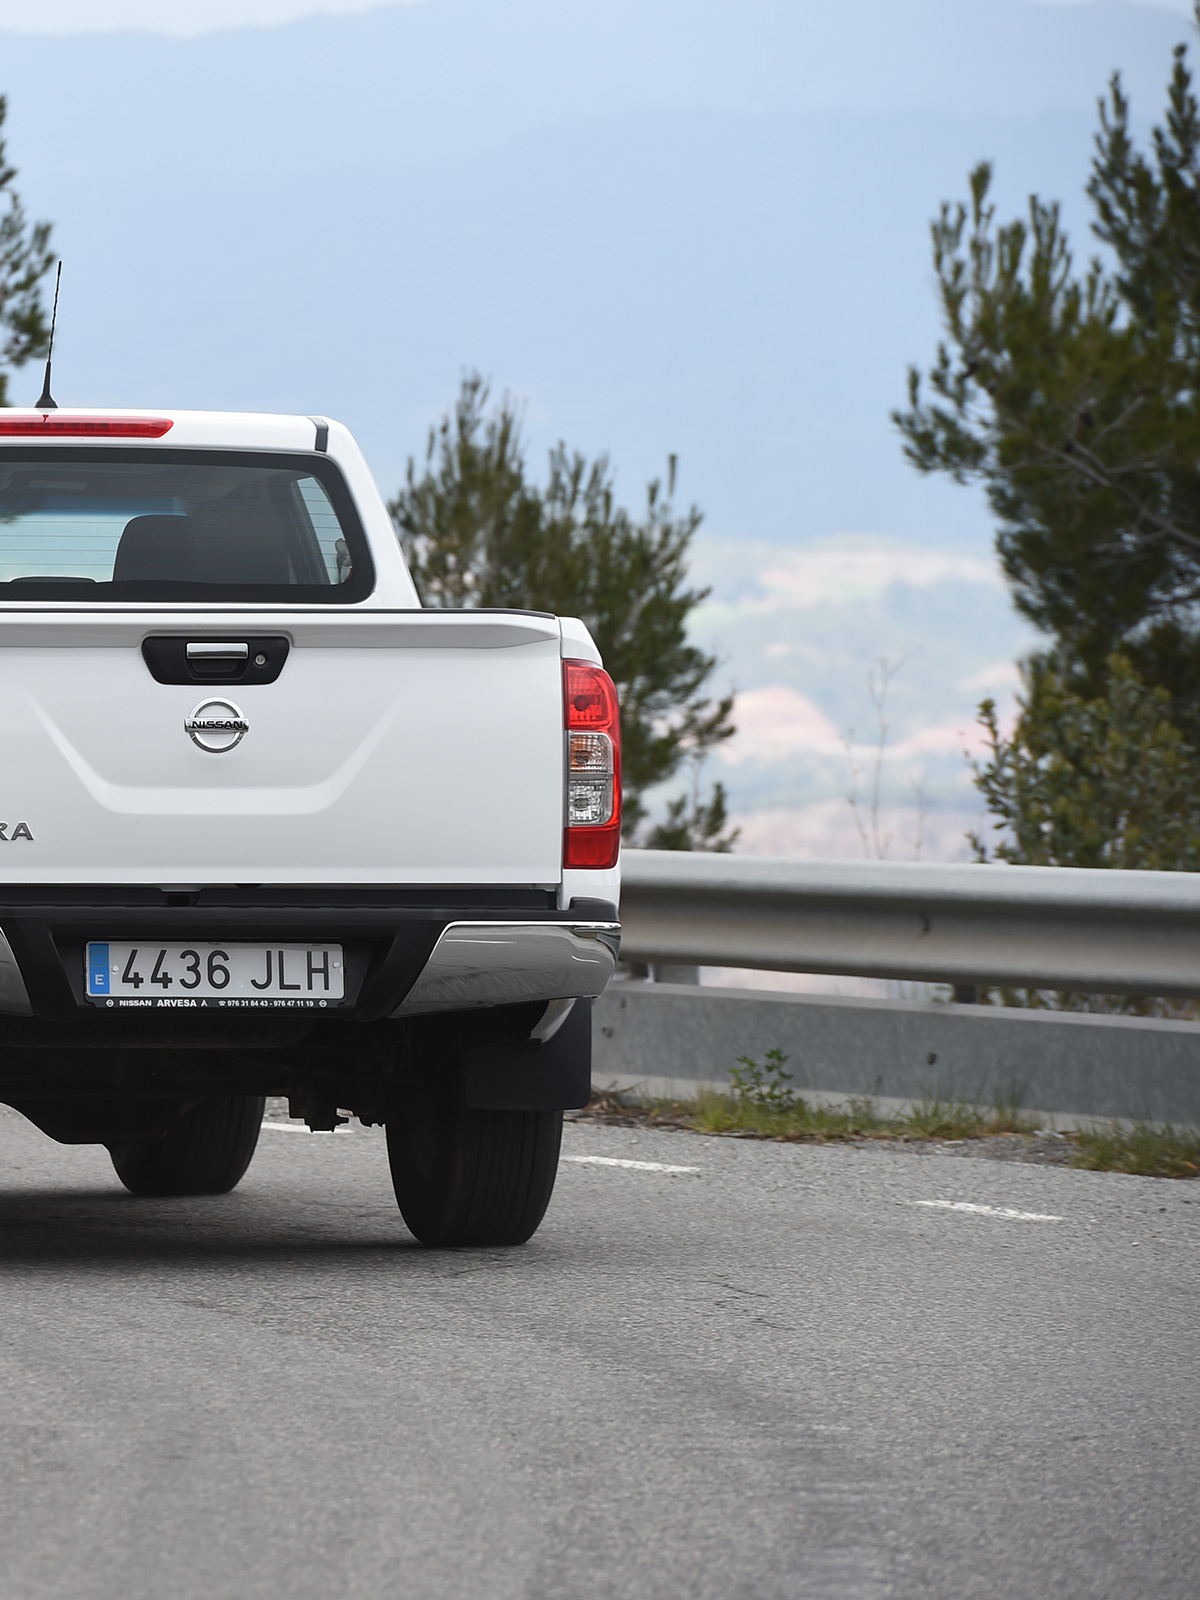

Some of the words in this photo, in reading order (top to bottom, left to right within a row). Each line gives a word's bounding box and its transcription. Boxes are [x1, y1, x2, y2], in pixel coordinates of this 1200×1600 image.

[191, 720, 243, 729] NISSAN
[121, 949, 231, 989] 4436
[250, 950, 330, 991] JLH
[95, 974, 105, 985] E
[157, 999, 197, 1007] ARVESA
